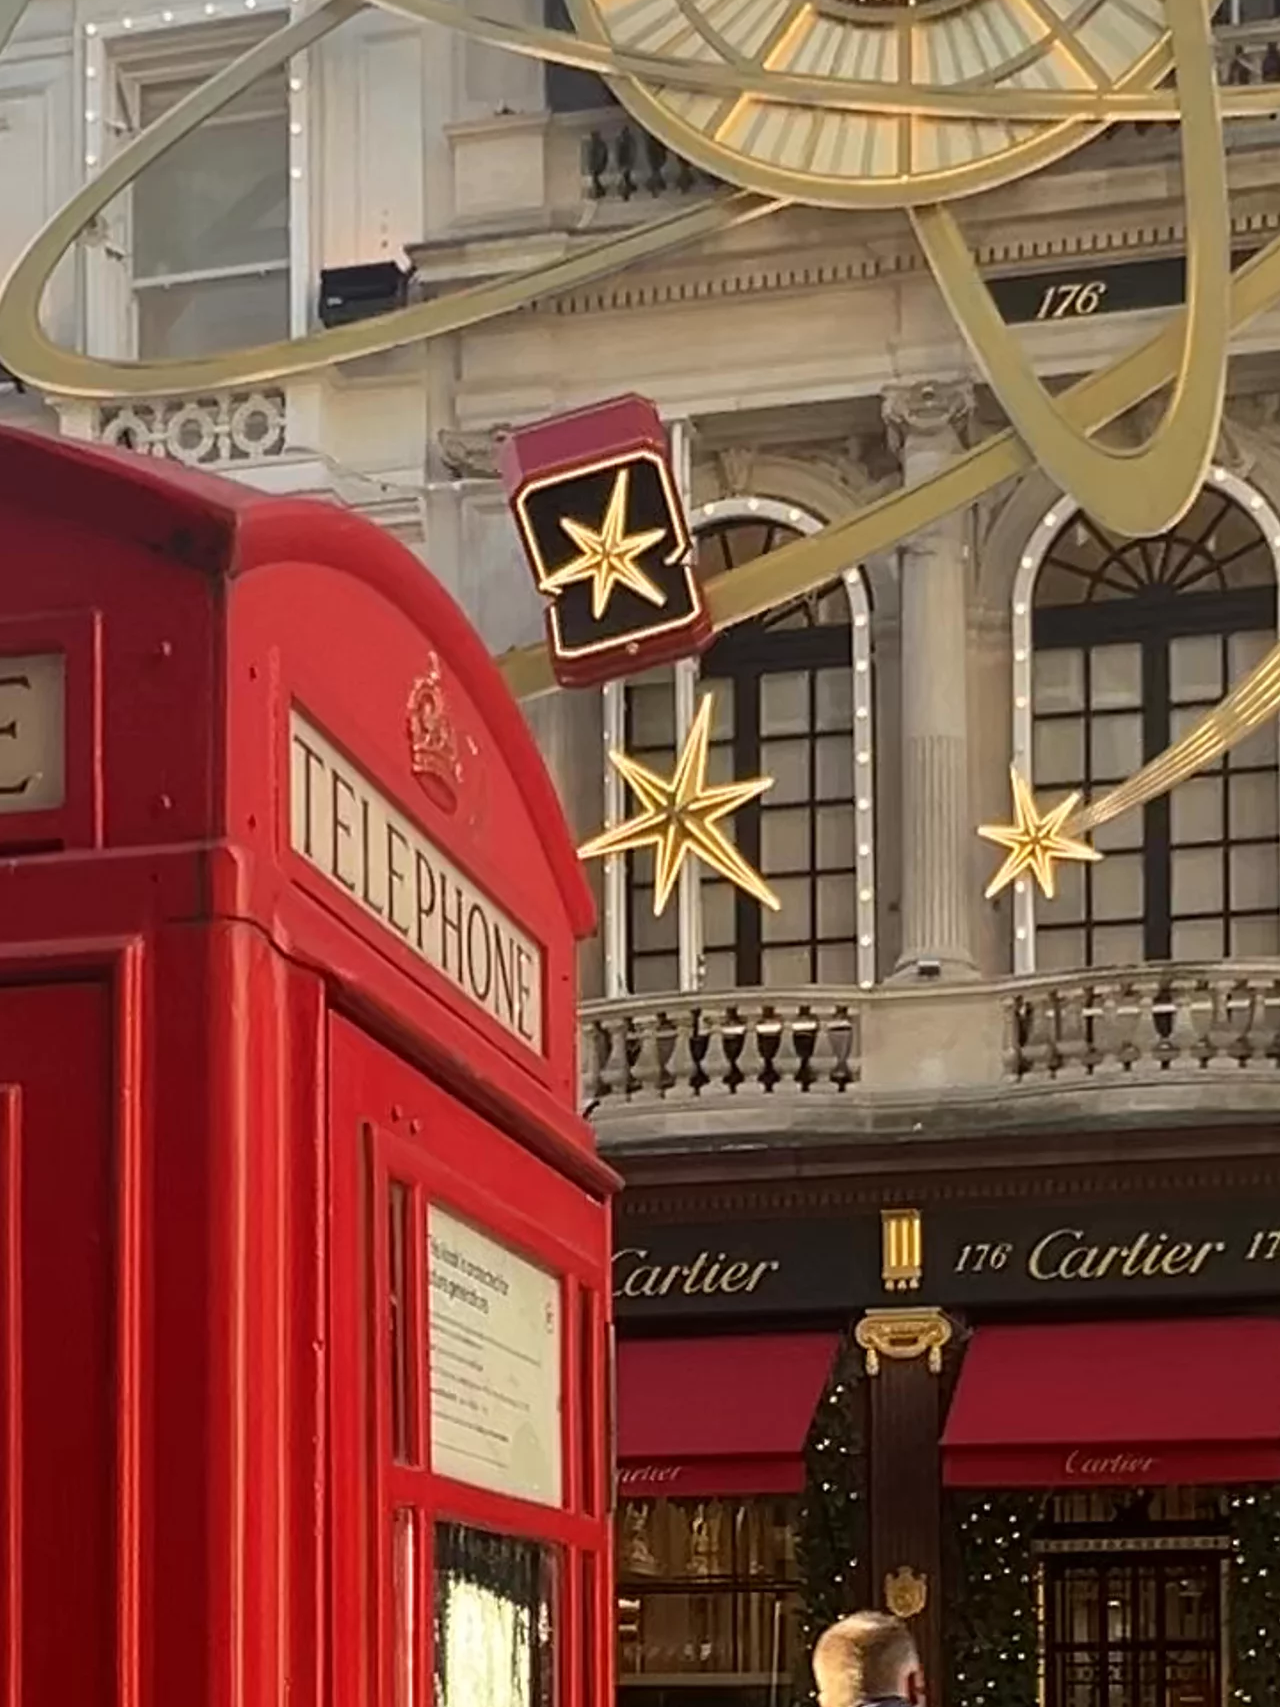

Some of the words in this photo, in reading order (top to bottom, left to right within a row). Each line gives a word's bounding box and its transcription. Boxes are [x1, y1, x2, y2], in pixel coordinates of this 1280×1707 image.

[1036, 280, 1107, 320] 176
[292, 731, 535, 1043] TELEPHONE
[954, 1242, 1014, 1274] 176
[1027, 1228, 1226, 1281] Cartier
[1065, 1449, 1157, 1474] Cartier
